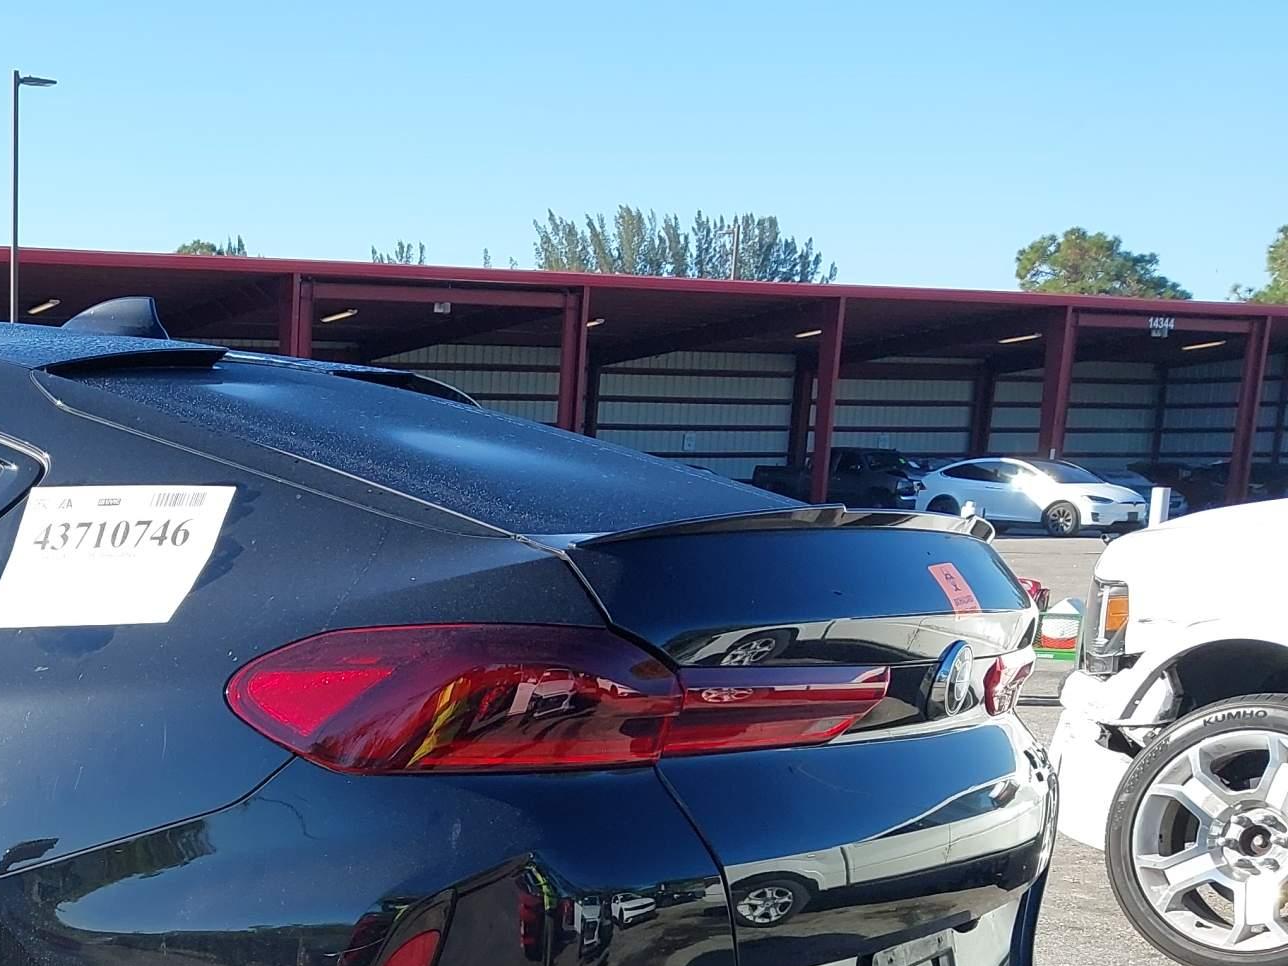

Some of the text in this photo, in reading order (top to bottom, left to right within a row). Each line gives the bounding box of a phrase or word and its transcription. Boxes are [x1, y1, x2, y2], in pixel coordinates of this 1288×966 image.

[1148, 317, 1175, 329] 14344
[33, 518, 194, 551] 43710746
[1202, 709, 1268, 727] KUMHO
